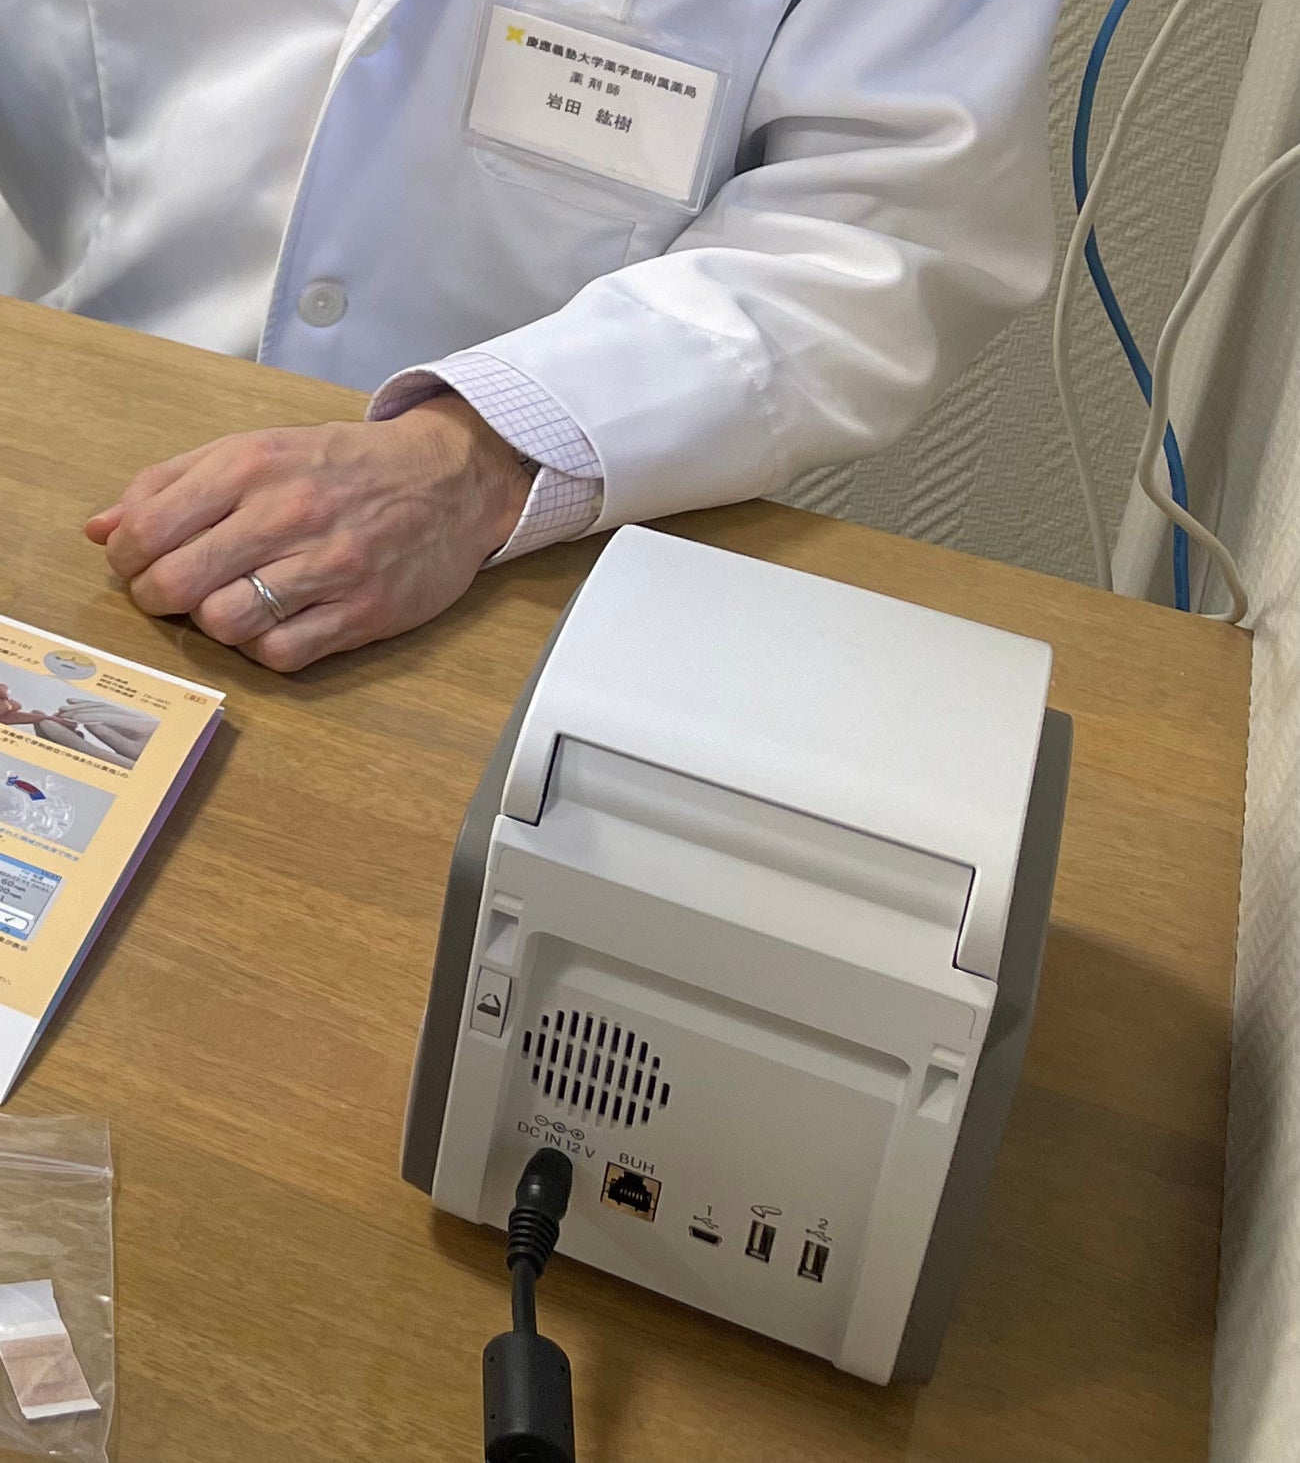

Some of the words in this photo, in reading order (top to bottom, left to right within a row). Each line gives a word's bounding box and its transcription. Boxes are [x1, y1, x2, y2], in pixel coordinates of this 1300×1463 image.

[545, 91, 583, 116] 岩田
[517, 1121, 540, 1138] DC
[544, 1132, 562, 1147] IN
[567, 1139, 581, 1154] 12
[585, 1146, 596, 1159] V
[619, 1152, 656, 1175] BUH
